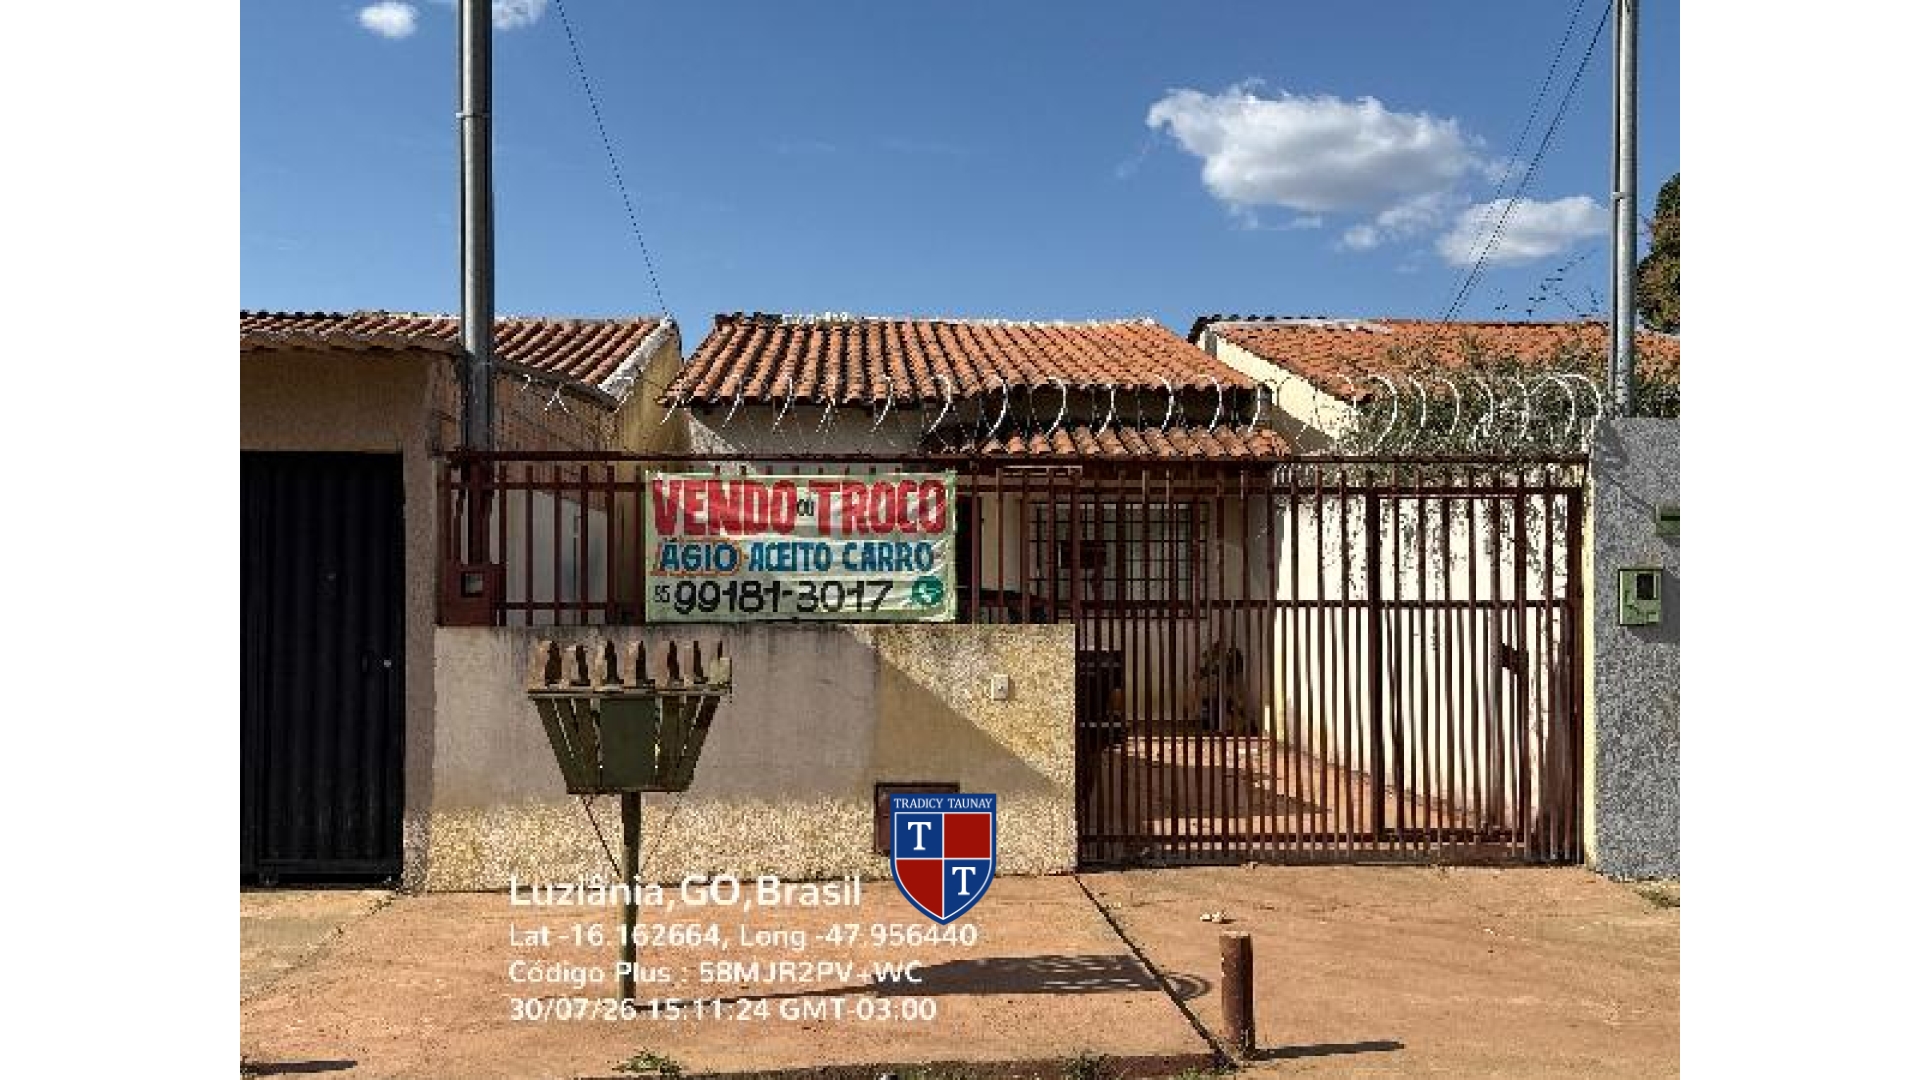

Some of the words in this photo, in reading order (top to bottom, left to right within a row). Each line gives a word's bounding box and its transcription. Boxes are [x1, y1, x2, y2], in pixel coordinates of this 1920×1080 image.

[652, 480, 796, 535] VENDO
[808, 480, 946, 535] TROCO
[749, 542, 830, 571] ACEITO
[843, 542, 934, 571] CARRO
[674, 581, 893, 613] 99181-3017
